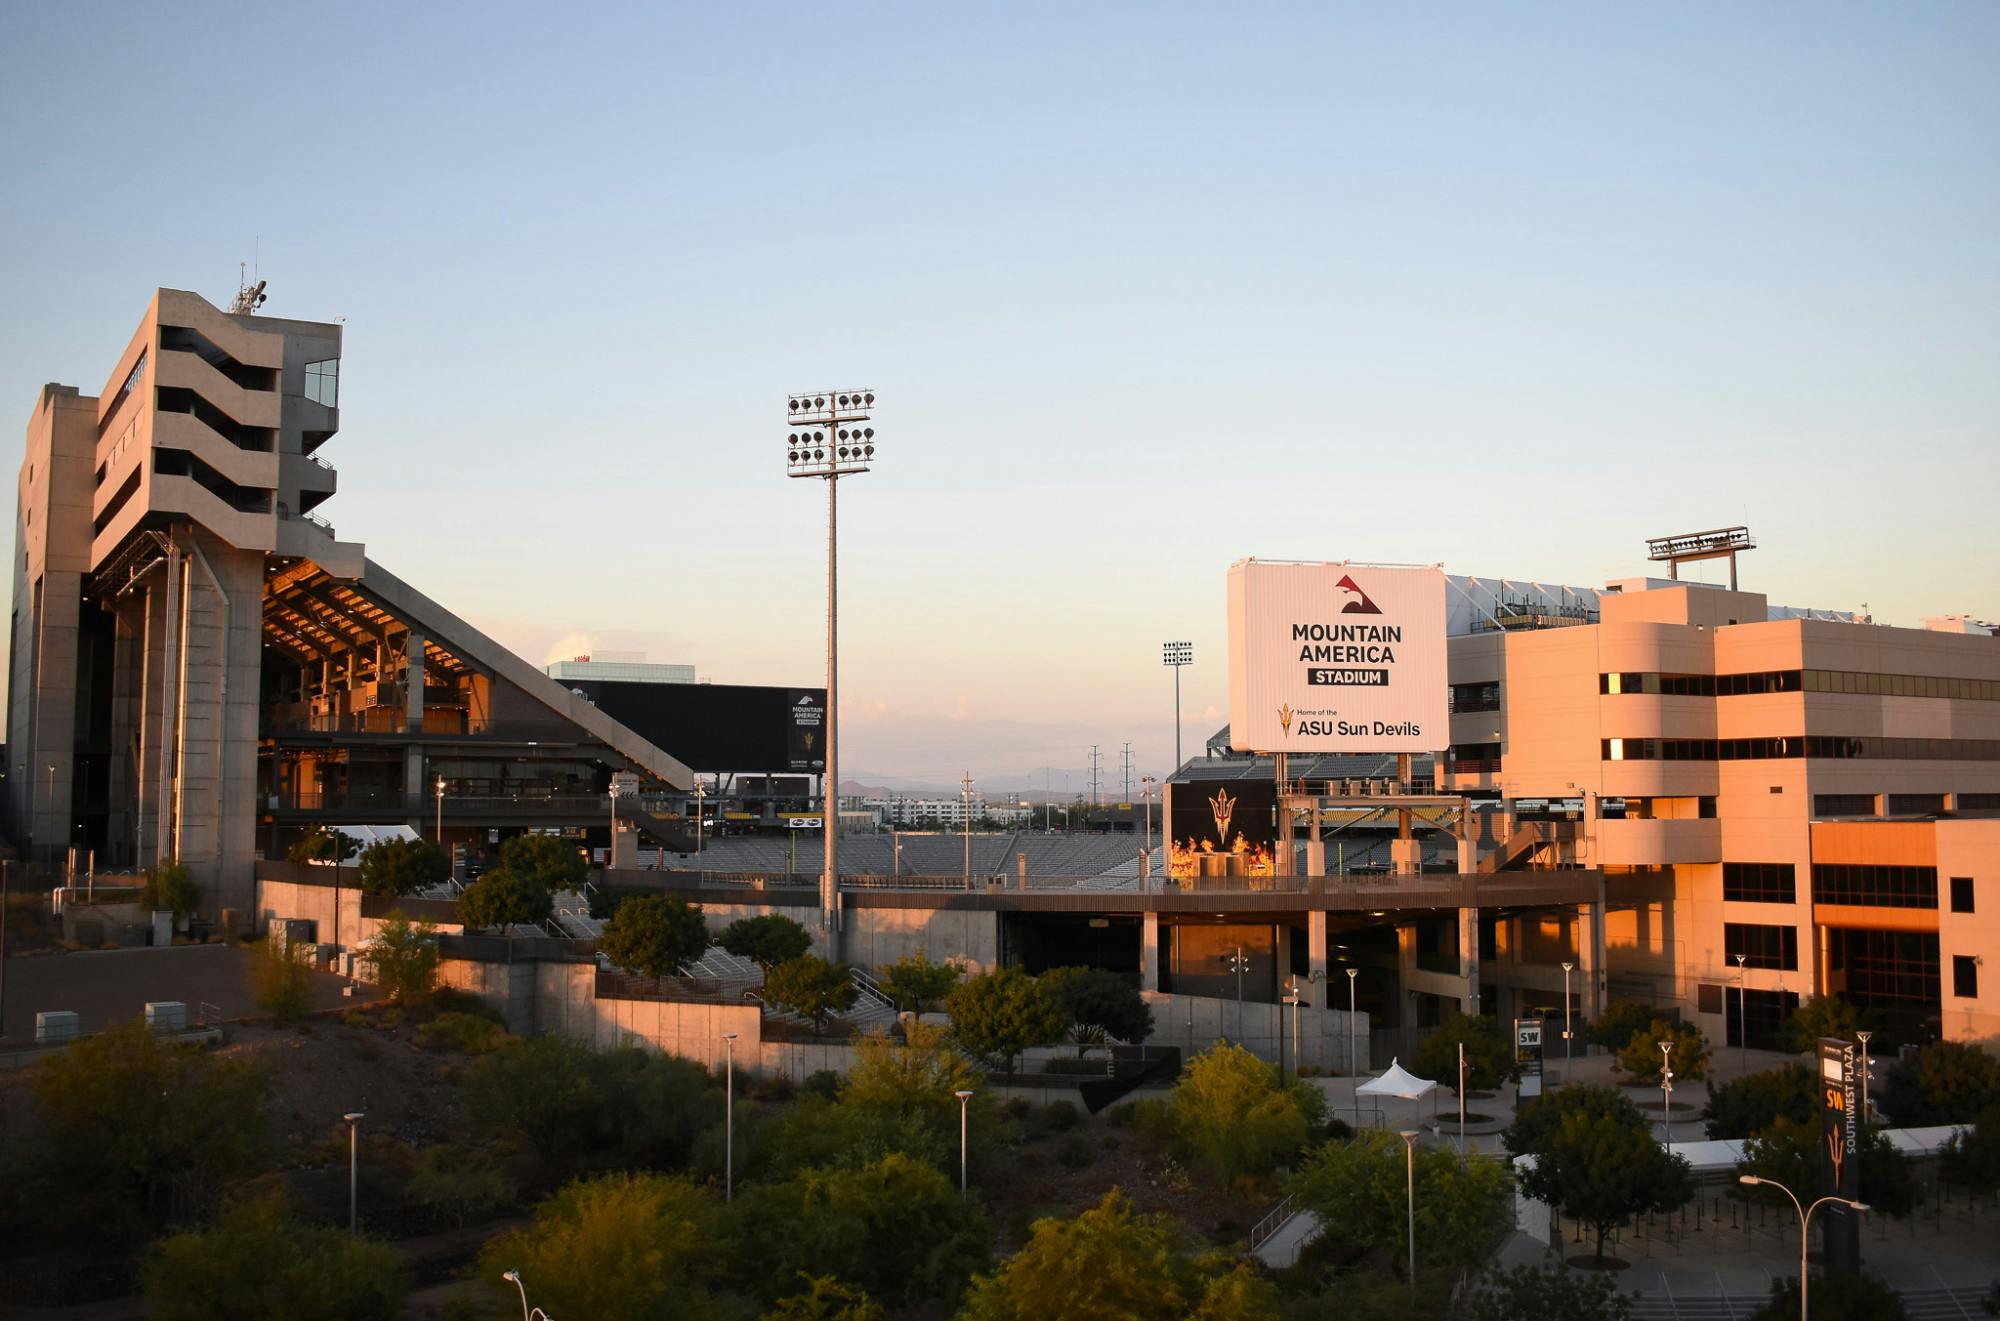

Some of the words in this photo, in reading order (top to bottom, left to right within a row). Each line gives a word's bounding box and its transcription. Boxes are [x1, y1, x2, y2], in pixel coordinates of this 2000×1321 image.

[1292, 624, 1401, 642] MOUNTAIN
[1299, 645, 1395, 663] AMERICA
[1315, 670, 1381, 684] STADIUM
[1298, 721, 1333, 736] ASU
[1338, 721, 1368, 736] Sun
[1373, 721, 1420, 736] Devils
[1520, 1032, 1538, 1042] SW
[1844, 1045, 1854, 1082] PLAZA
[1845, 1085, 1856, 1154] SOUTHWEST
